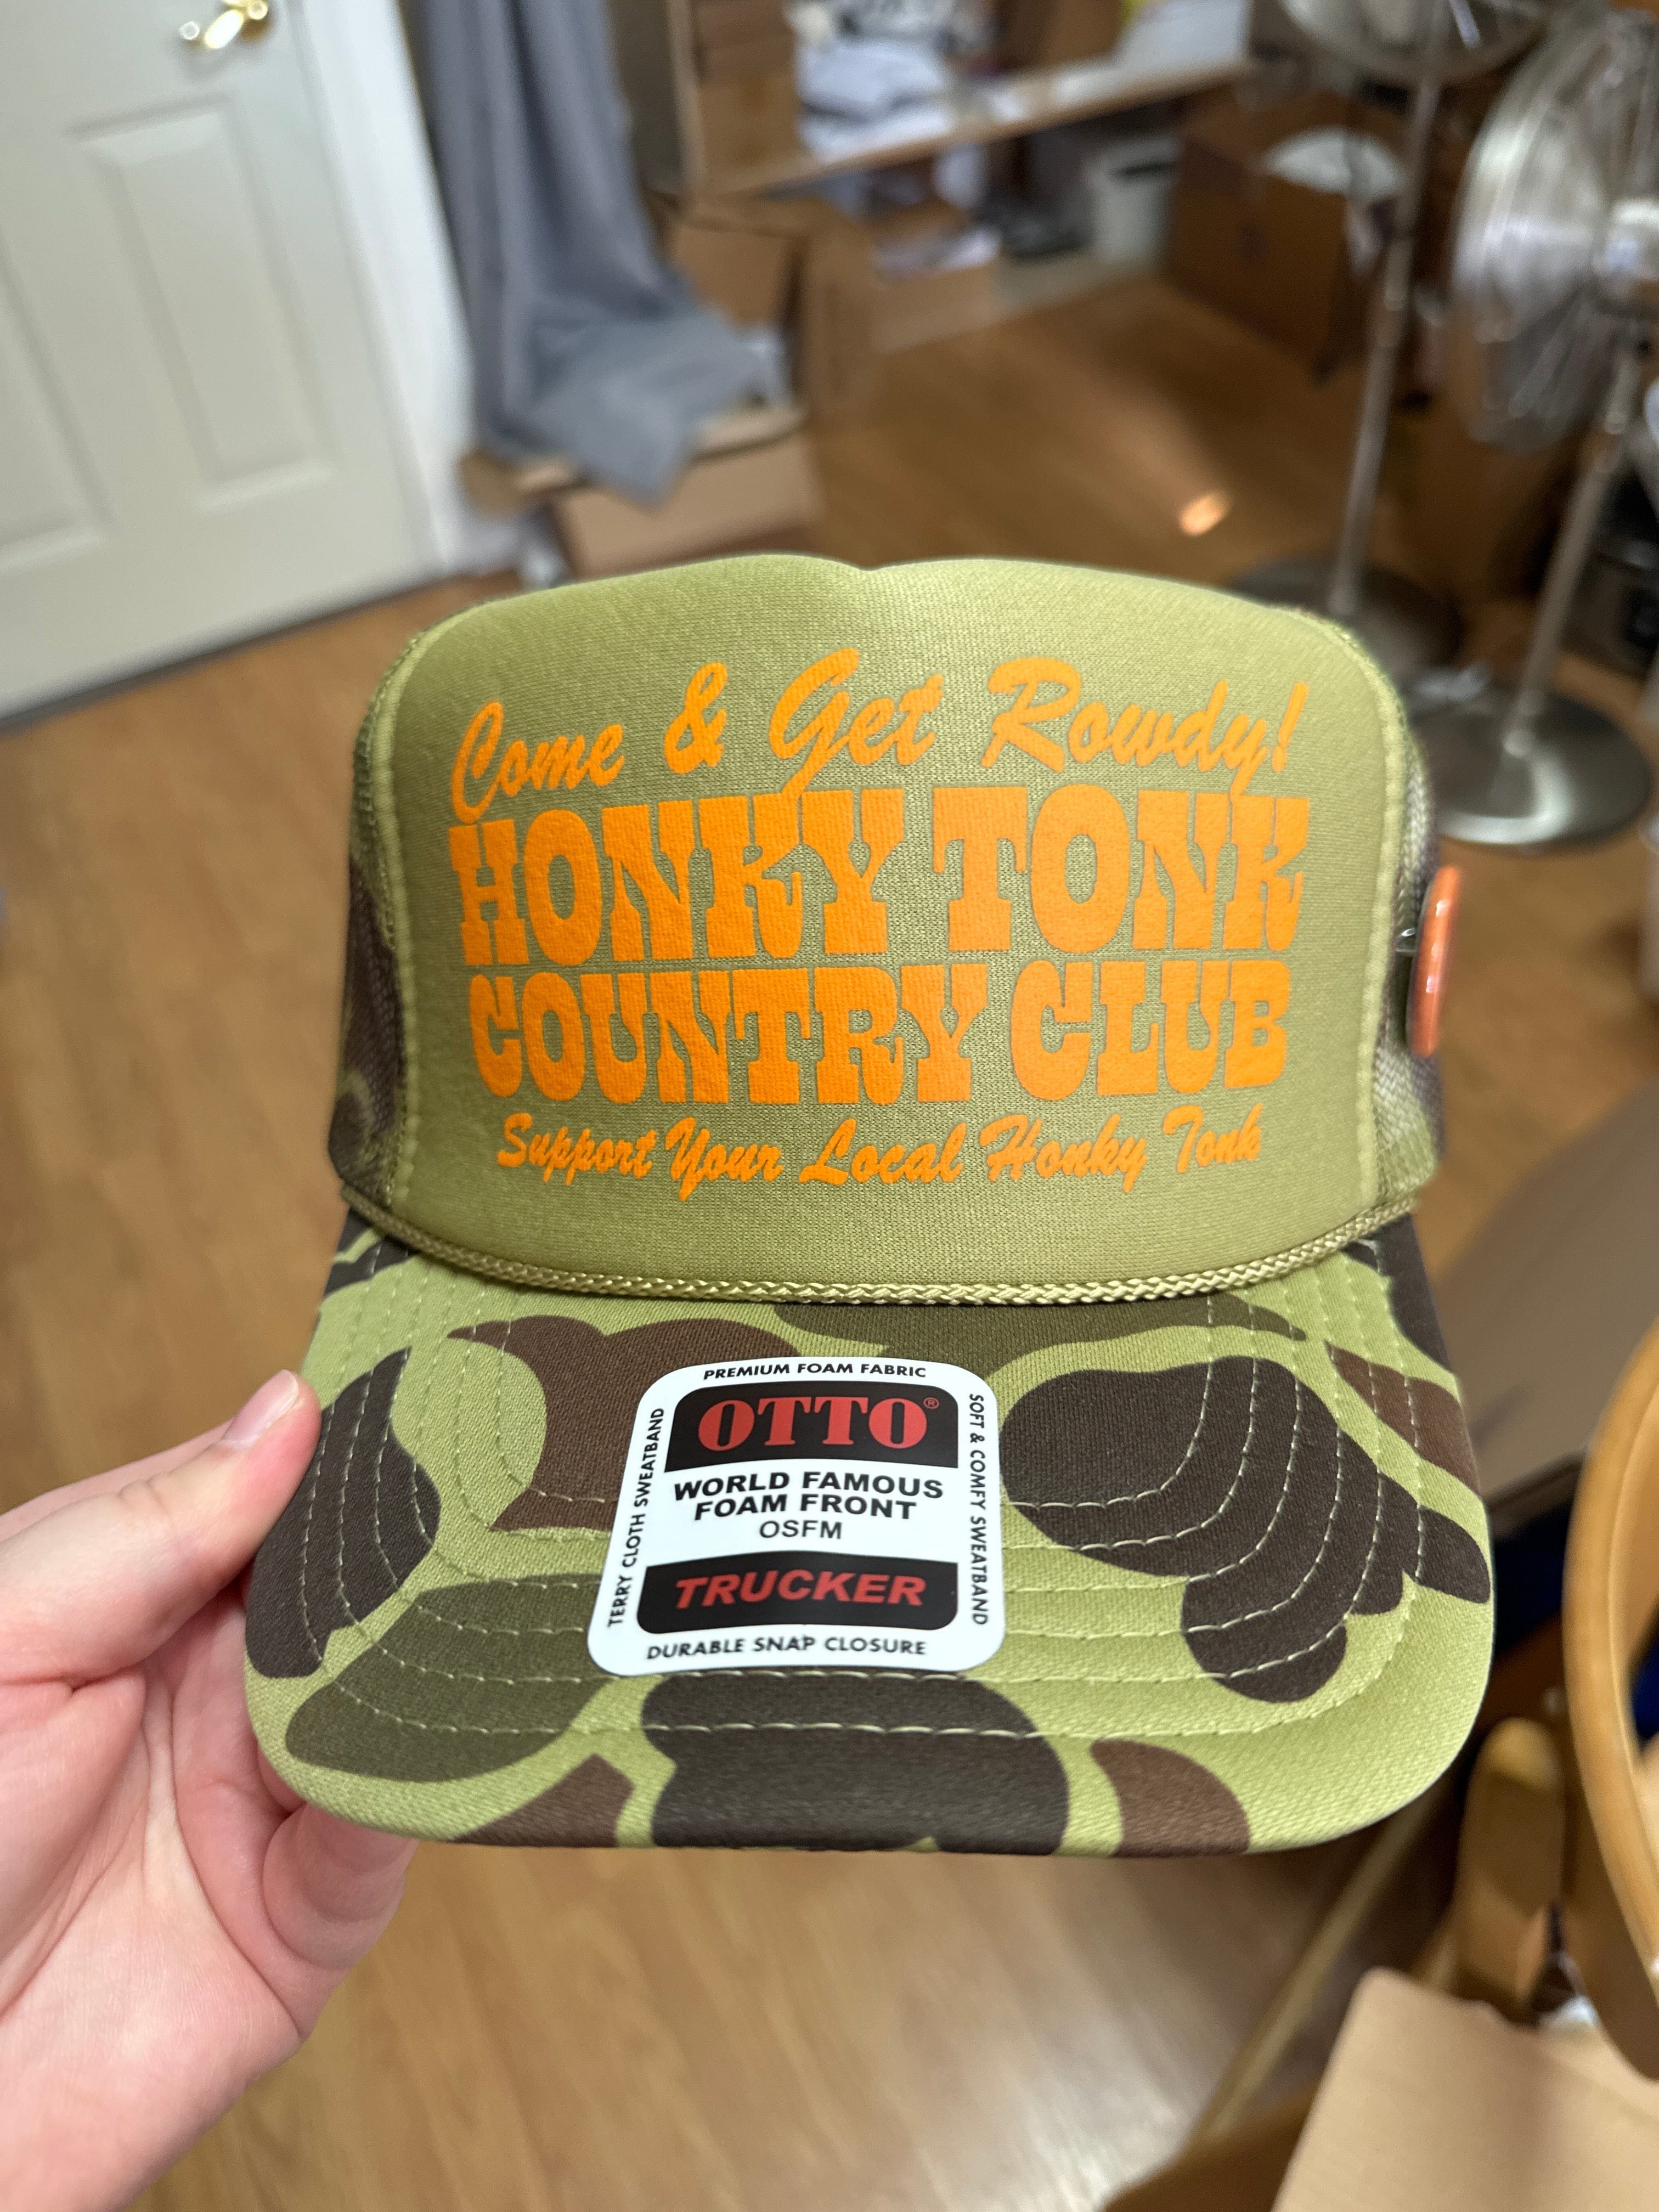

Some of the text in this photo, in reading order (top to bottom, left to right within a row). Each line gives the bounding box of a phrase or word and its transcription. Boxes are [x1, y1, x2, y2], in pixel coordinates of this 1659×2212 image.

[452, 648, 1308, 822] Come & Get Rowdy!
[449, 783, 1310, 966] HONKY TONK
[469, 960, 1290, 1105] COUNTRY CLUB
[497, 1103, 1261, 1201] Support Your Local Honky Tonk
[703, 1363, 927, 1380] PREMIUM FOAM FABRIC
[608, 1408, 664, 1627] TERRY CLOTH SWEATBAND
[674, 1471, 943, 1500] WORLD FAMOUS
[695, 1494, 917, 1520] FOAM FRONT
[969, 1393, 989, 1625] SOFT & COMFY SWEATBAND
[759, 1521, 842, 1539] OSFM
[676, 1569, 927, 1609] TRUCKER
[647, 1637, 927, 1660] DURABLE SNAP CLOSURE
